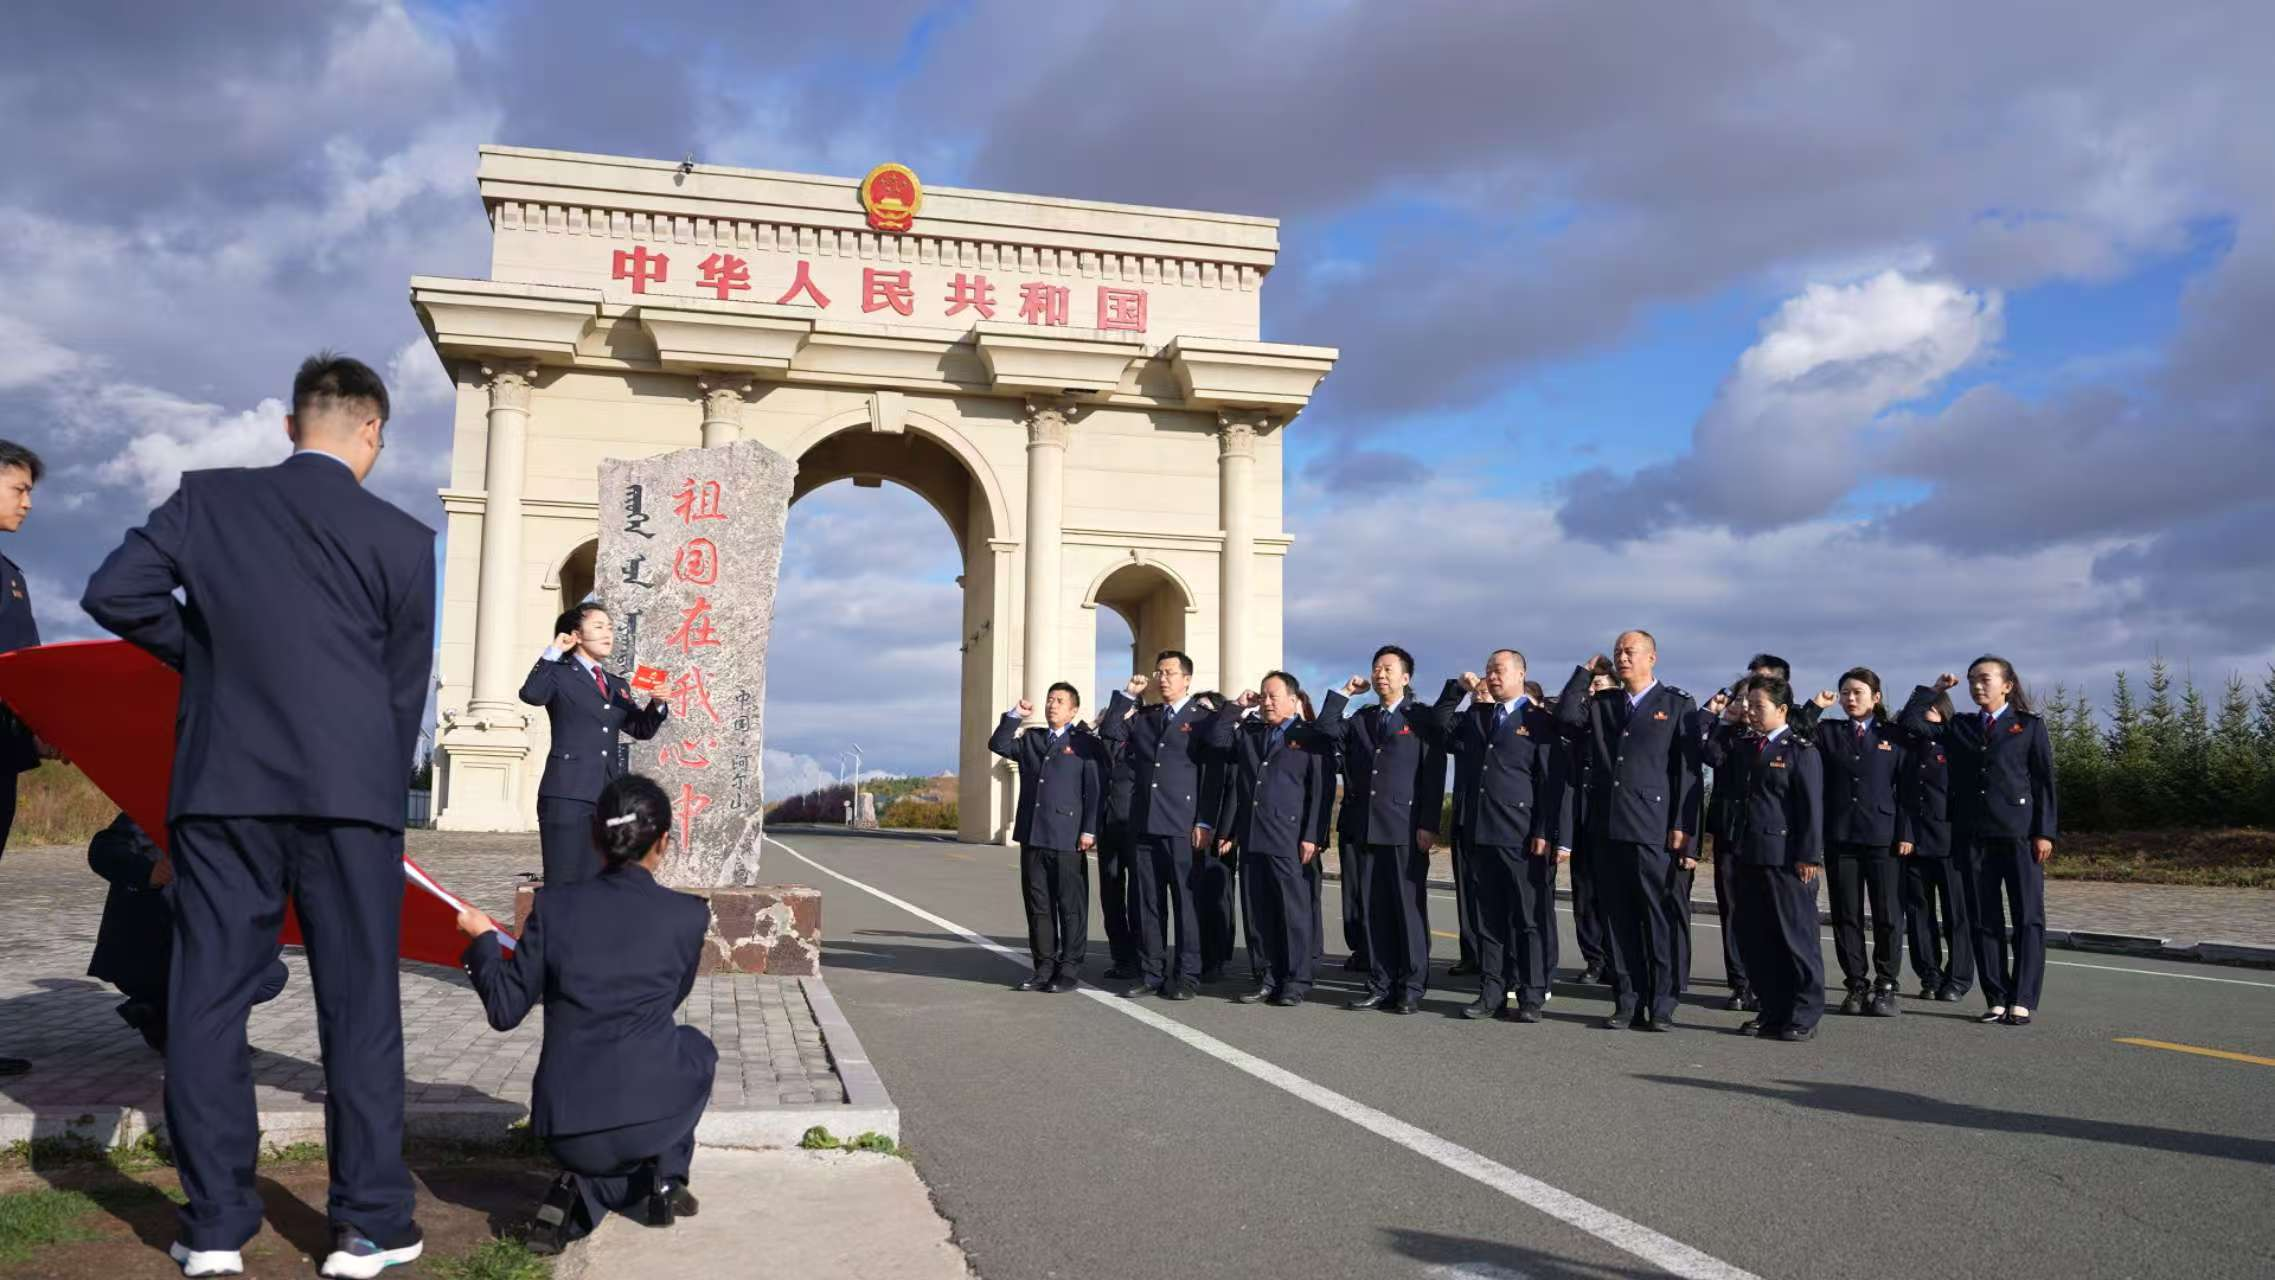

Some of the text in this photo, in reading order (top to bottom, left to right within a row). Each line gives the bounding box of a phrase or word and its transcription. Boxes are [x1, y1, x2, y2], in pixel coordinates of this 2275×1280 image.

[612, 245, 1148, 333] 中华人民共和国
[658, 478, 728, 849] 祖国在我心中
